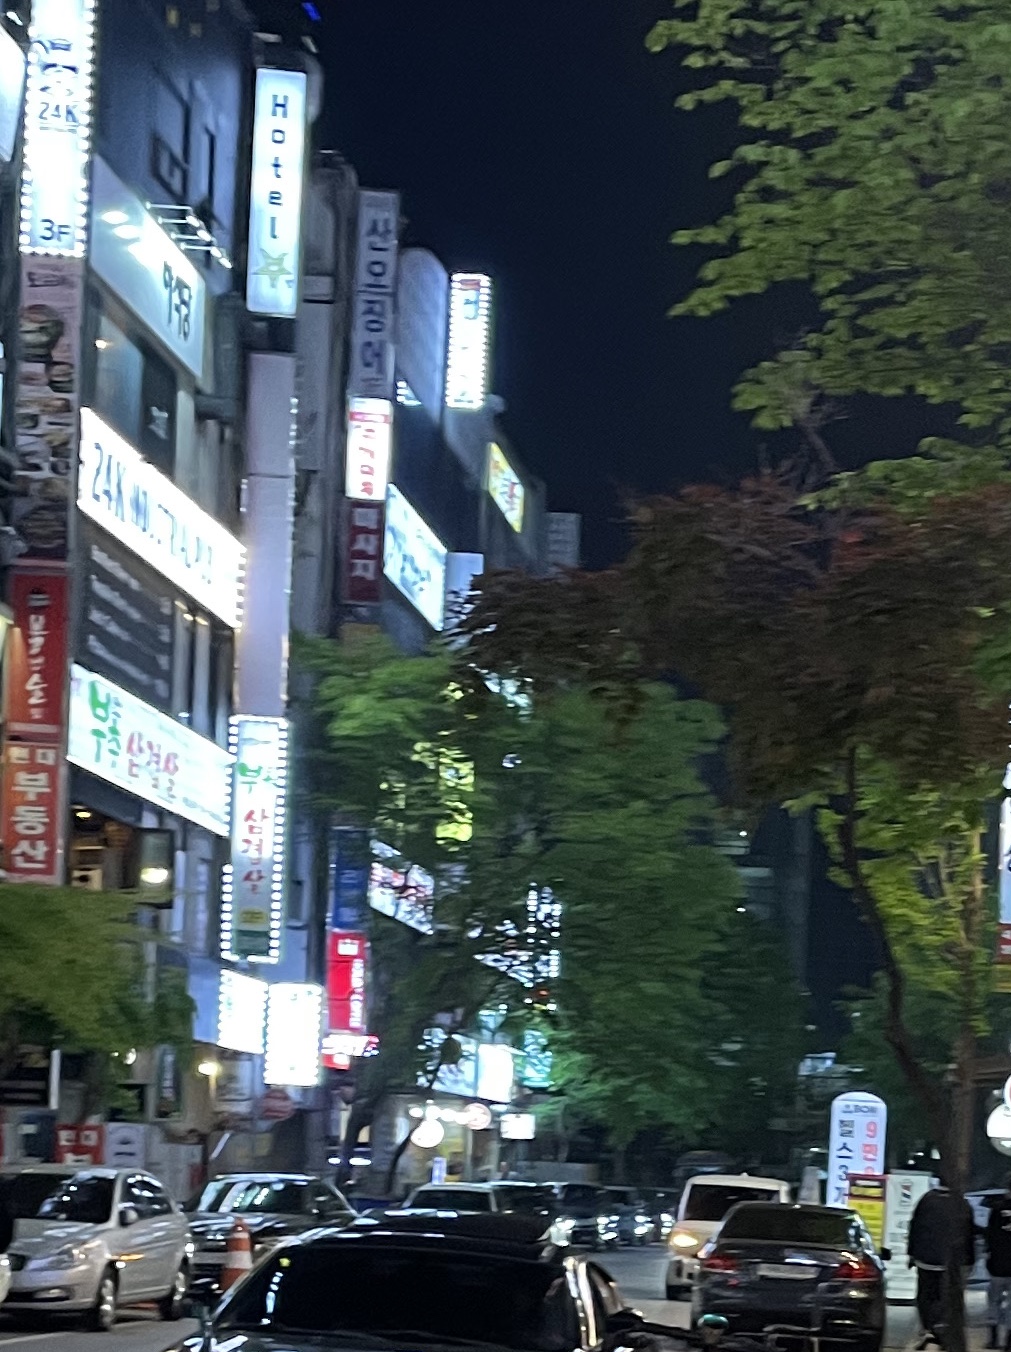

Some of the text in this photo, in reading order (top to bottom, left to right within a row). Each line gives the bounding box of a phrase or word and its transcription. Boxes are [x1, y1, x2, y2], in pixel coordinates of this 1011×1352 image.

[268, 94, 289, 240] Hotel
[39, 218, 71, 242] 3F
[10, 770, 52, 869] 부동산
